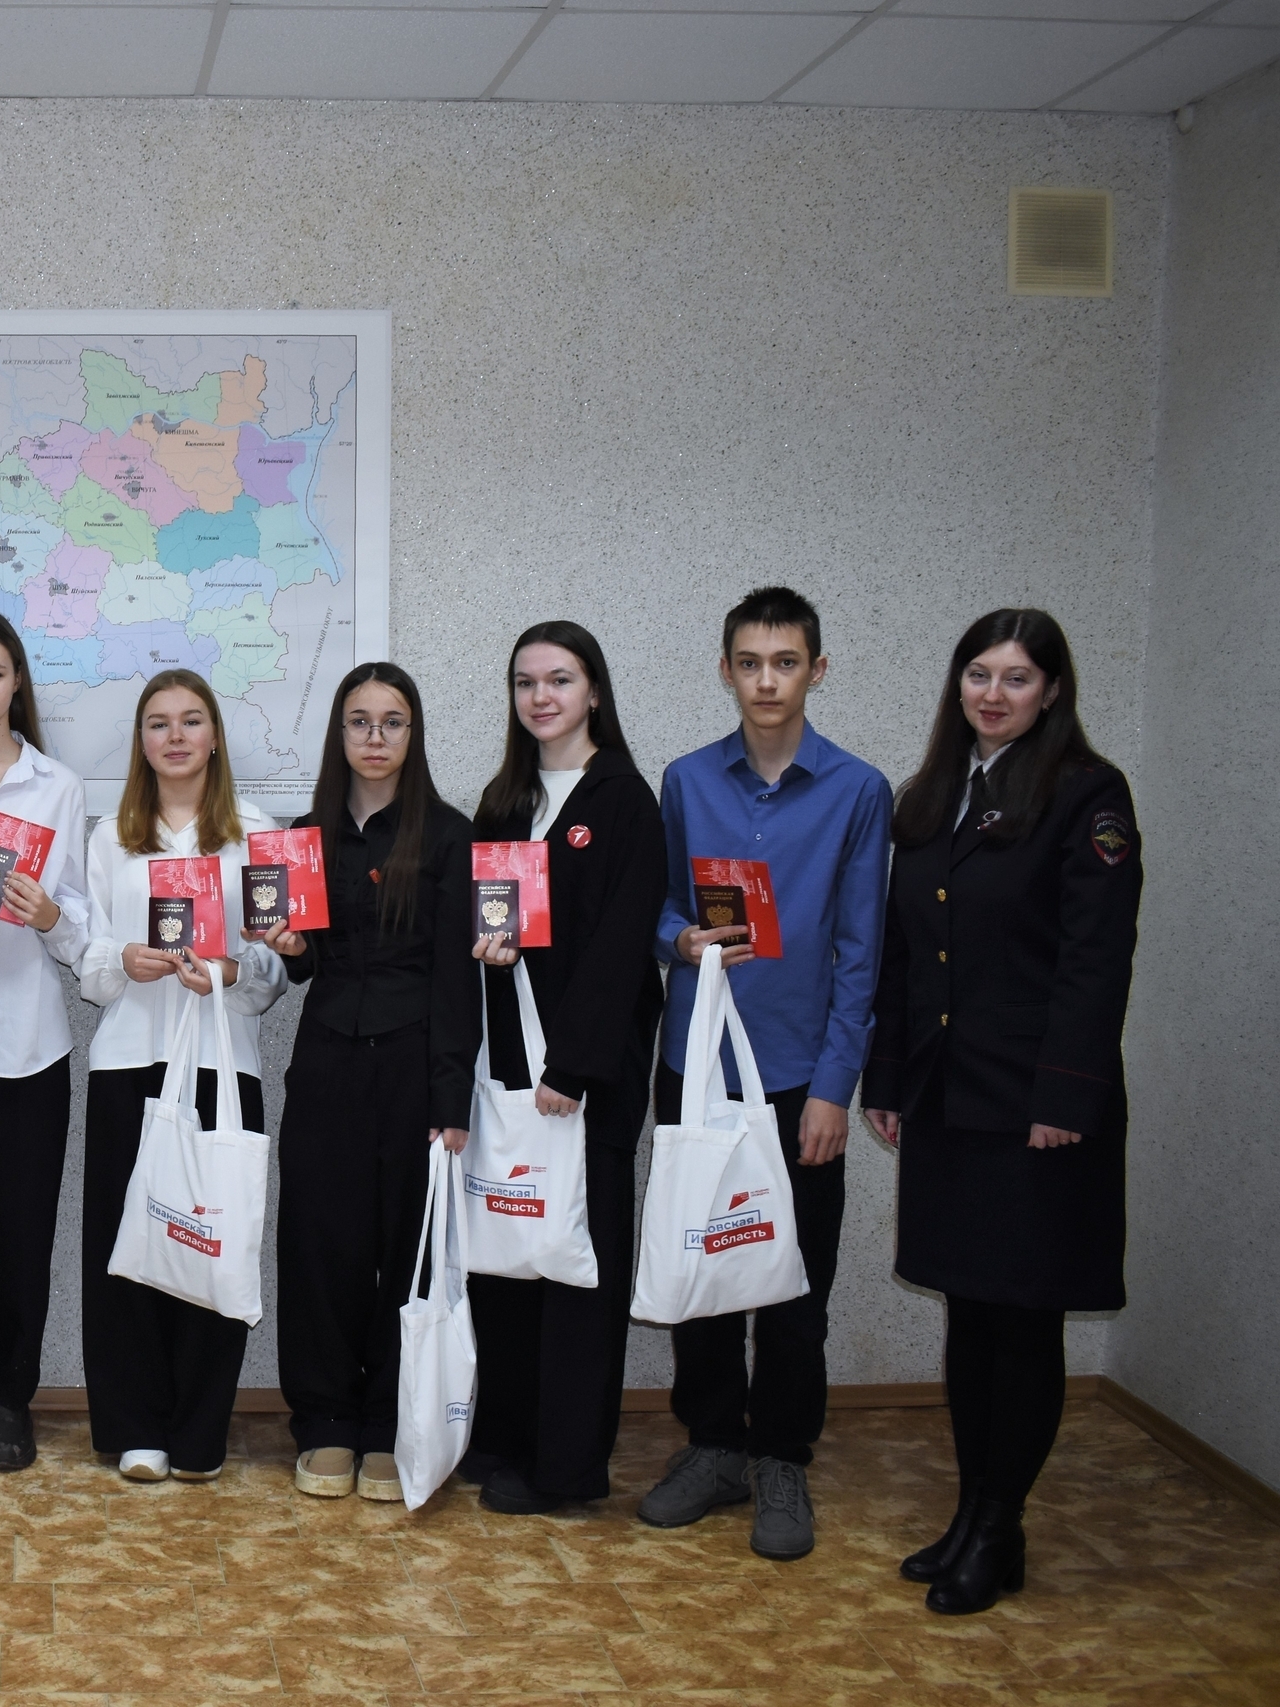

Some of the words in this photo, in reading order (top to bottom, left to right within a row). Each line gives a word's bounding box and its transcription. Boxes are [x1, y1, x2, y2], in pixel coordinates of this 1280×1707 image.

[292, 682, 312, 735] ПРИВОЛЖСКИЙ
[309, 630, 327, 681] ФЕДЕРАЛЬНЫЙ
[324, 606, 334, 629] ОКРУГ
[468, 1179, 530, 1198] Ивановская
[492, 1200, 538, 1213] область
[149, 1201, 206, 1237] Ивановская
[173, 1229, 214, 1252] область
[712, 1230, 766, 1248] область
